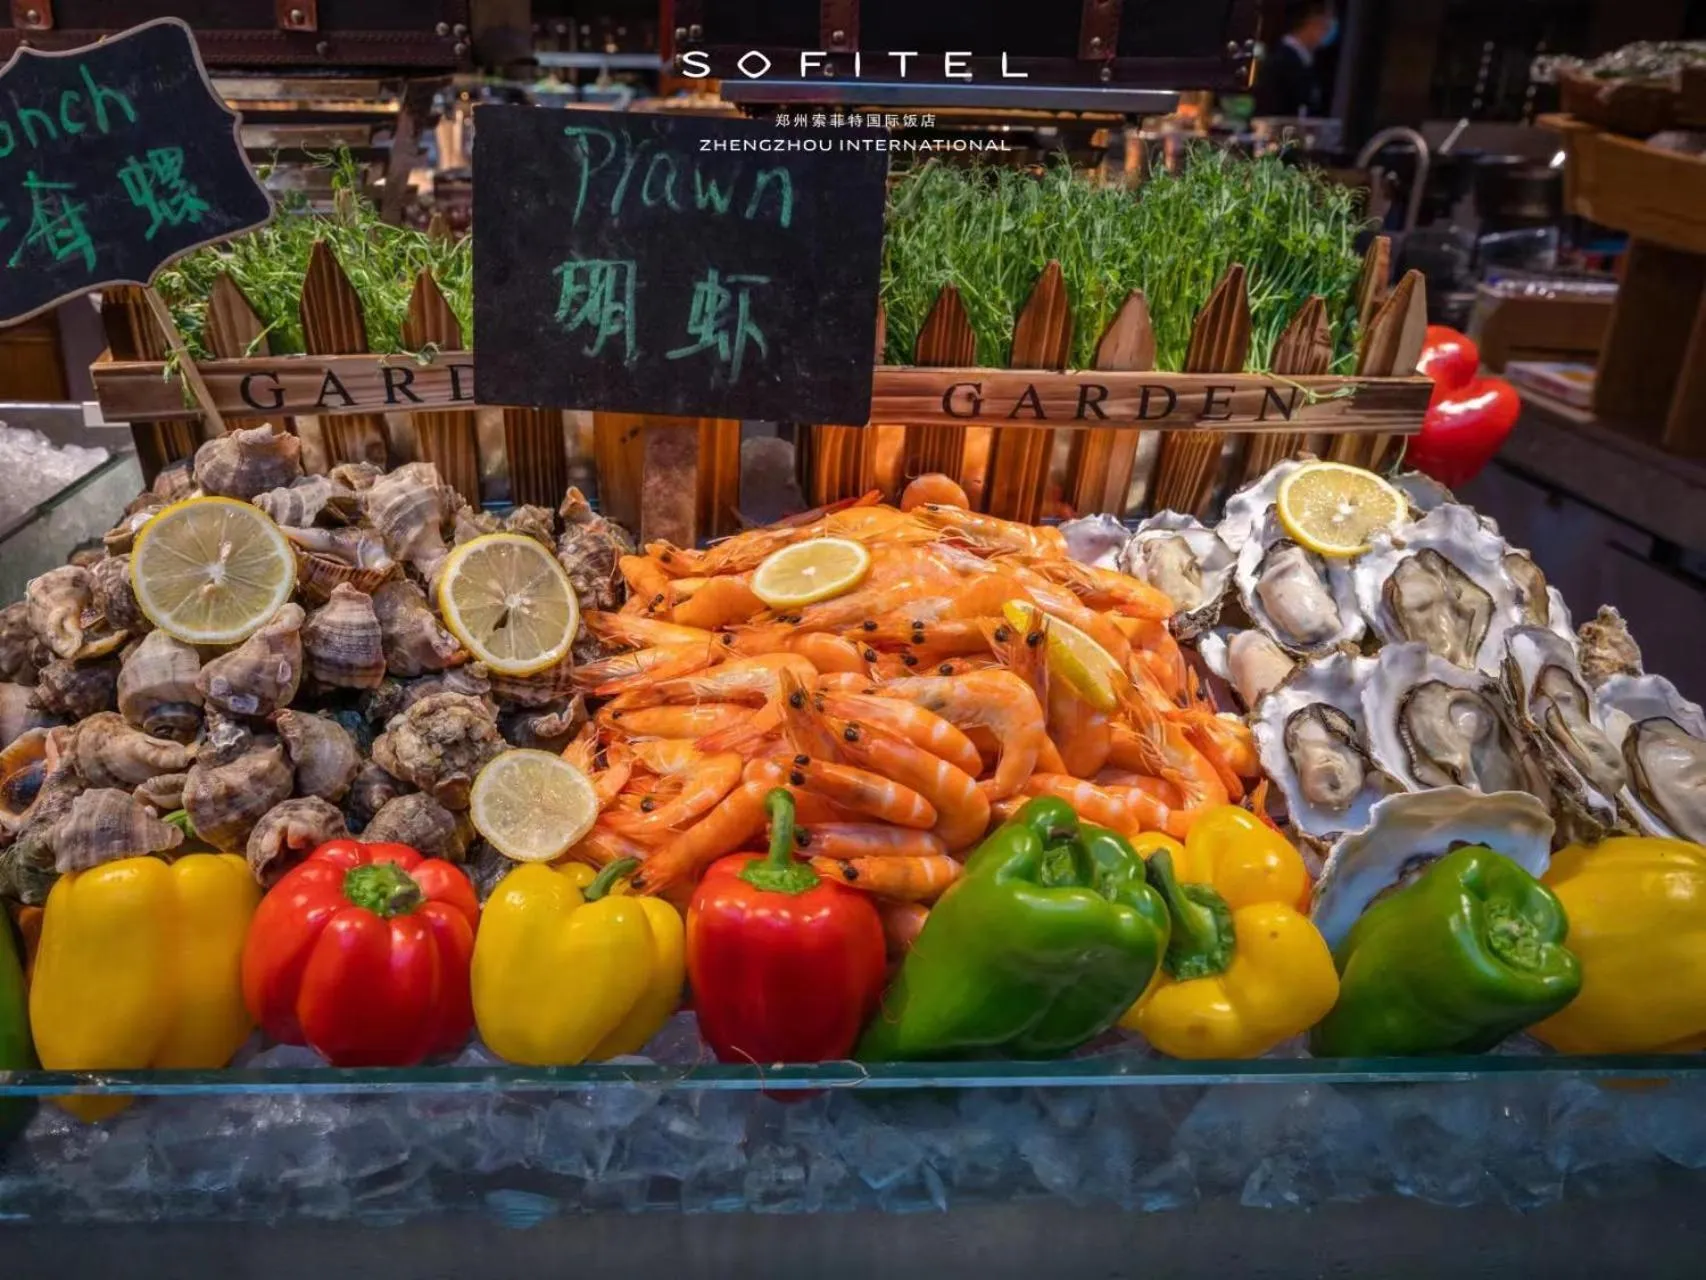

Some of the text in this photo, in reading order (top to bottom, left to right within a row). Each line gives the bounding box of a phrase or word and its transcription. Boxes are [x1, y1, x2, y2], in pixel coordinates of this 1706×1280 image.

[564, 126, 795, 228] Prawn
[552, 258, 772, 384] 明虾
[941, 382, 1298, 421] GARDEN
